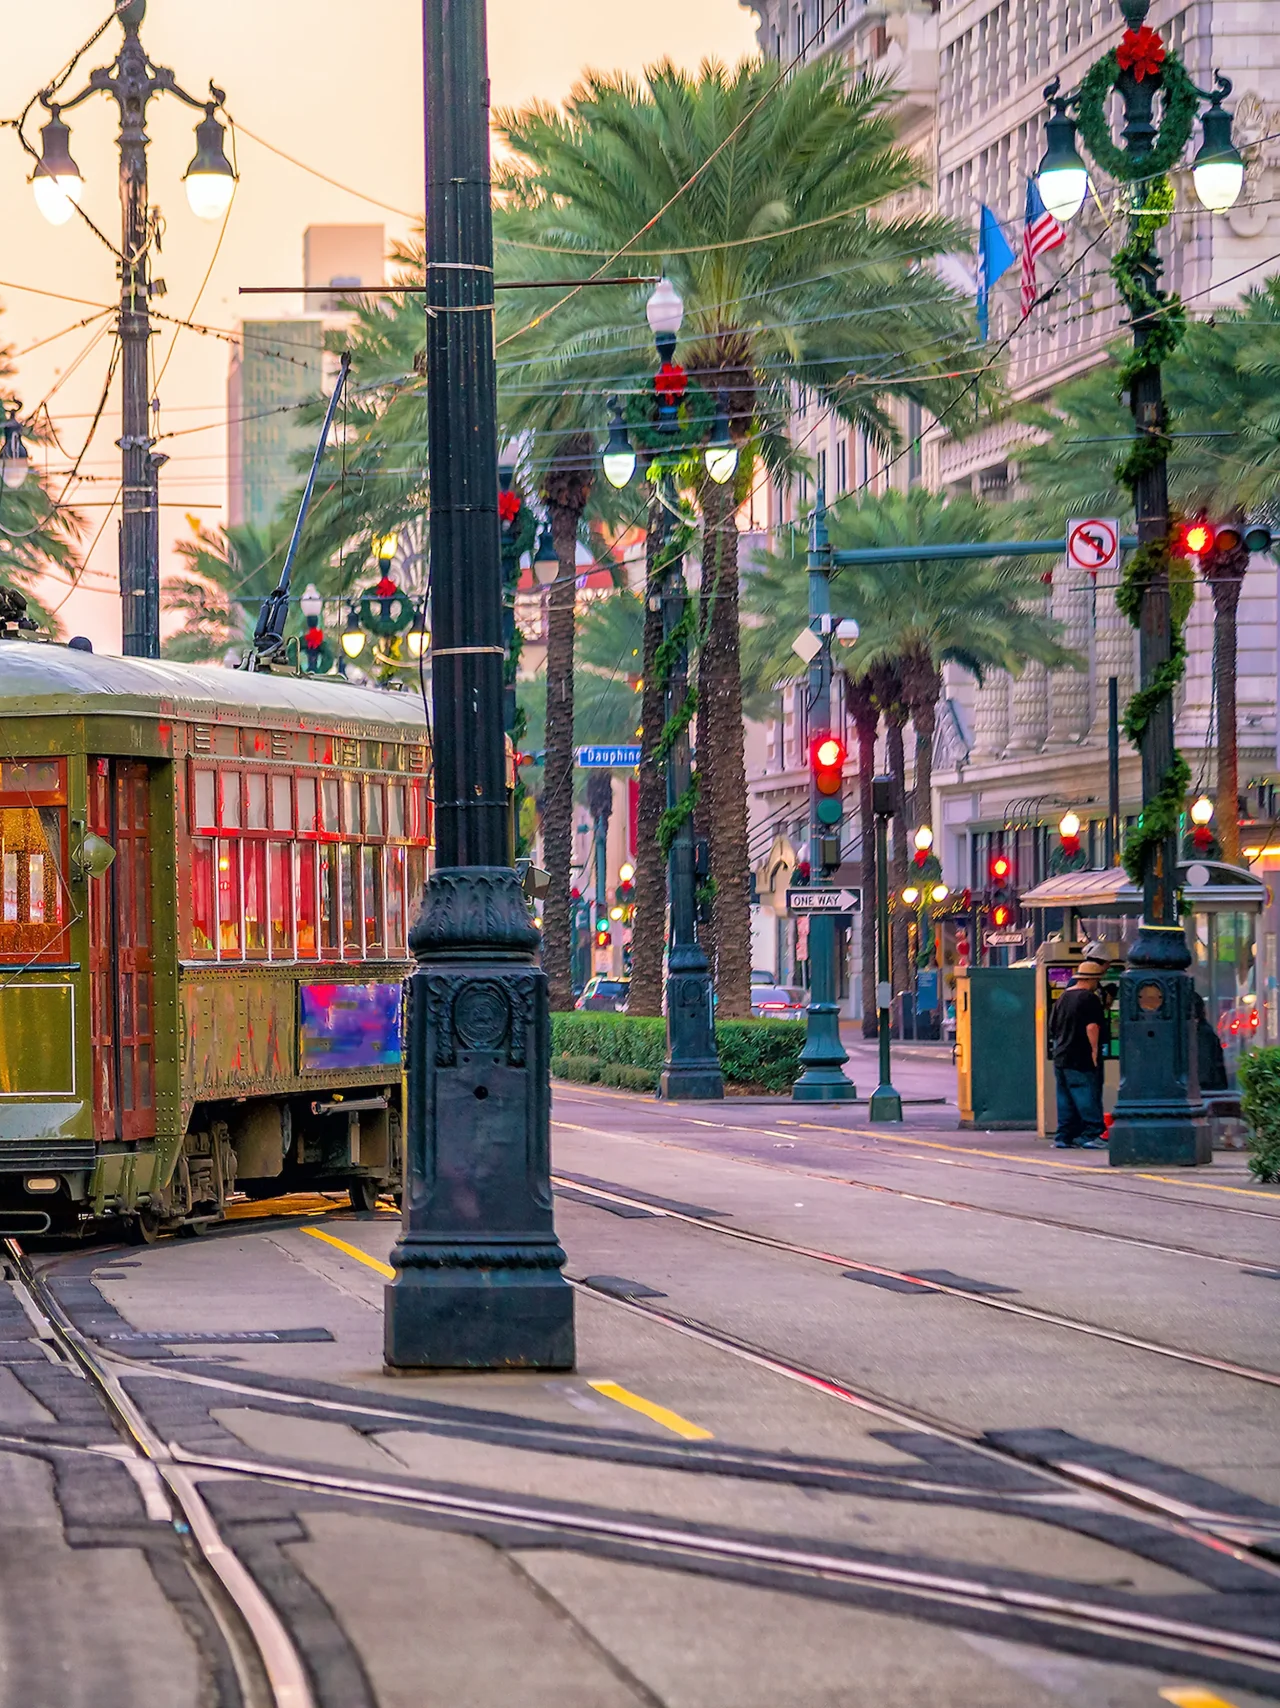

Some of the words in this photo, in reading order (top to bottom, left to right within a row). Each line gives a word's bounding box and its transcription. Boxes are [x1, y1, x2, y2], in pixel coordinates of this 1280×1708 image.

[588, 749, 641, 765] Dauphine
[794, 896, 814, 906] ONE
[818, 895, 839, 906] WAY
